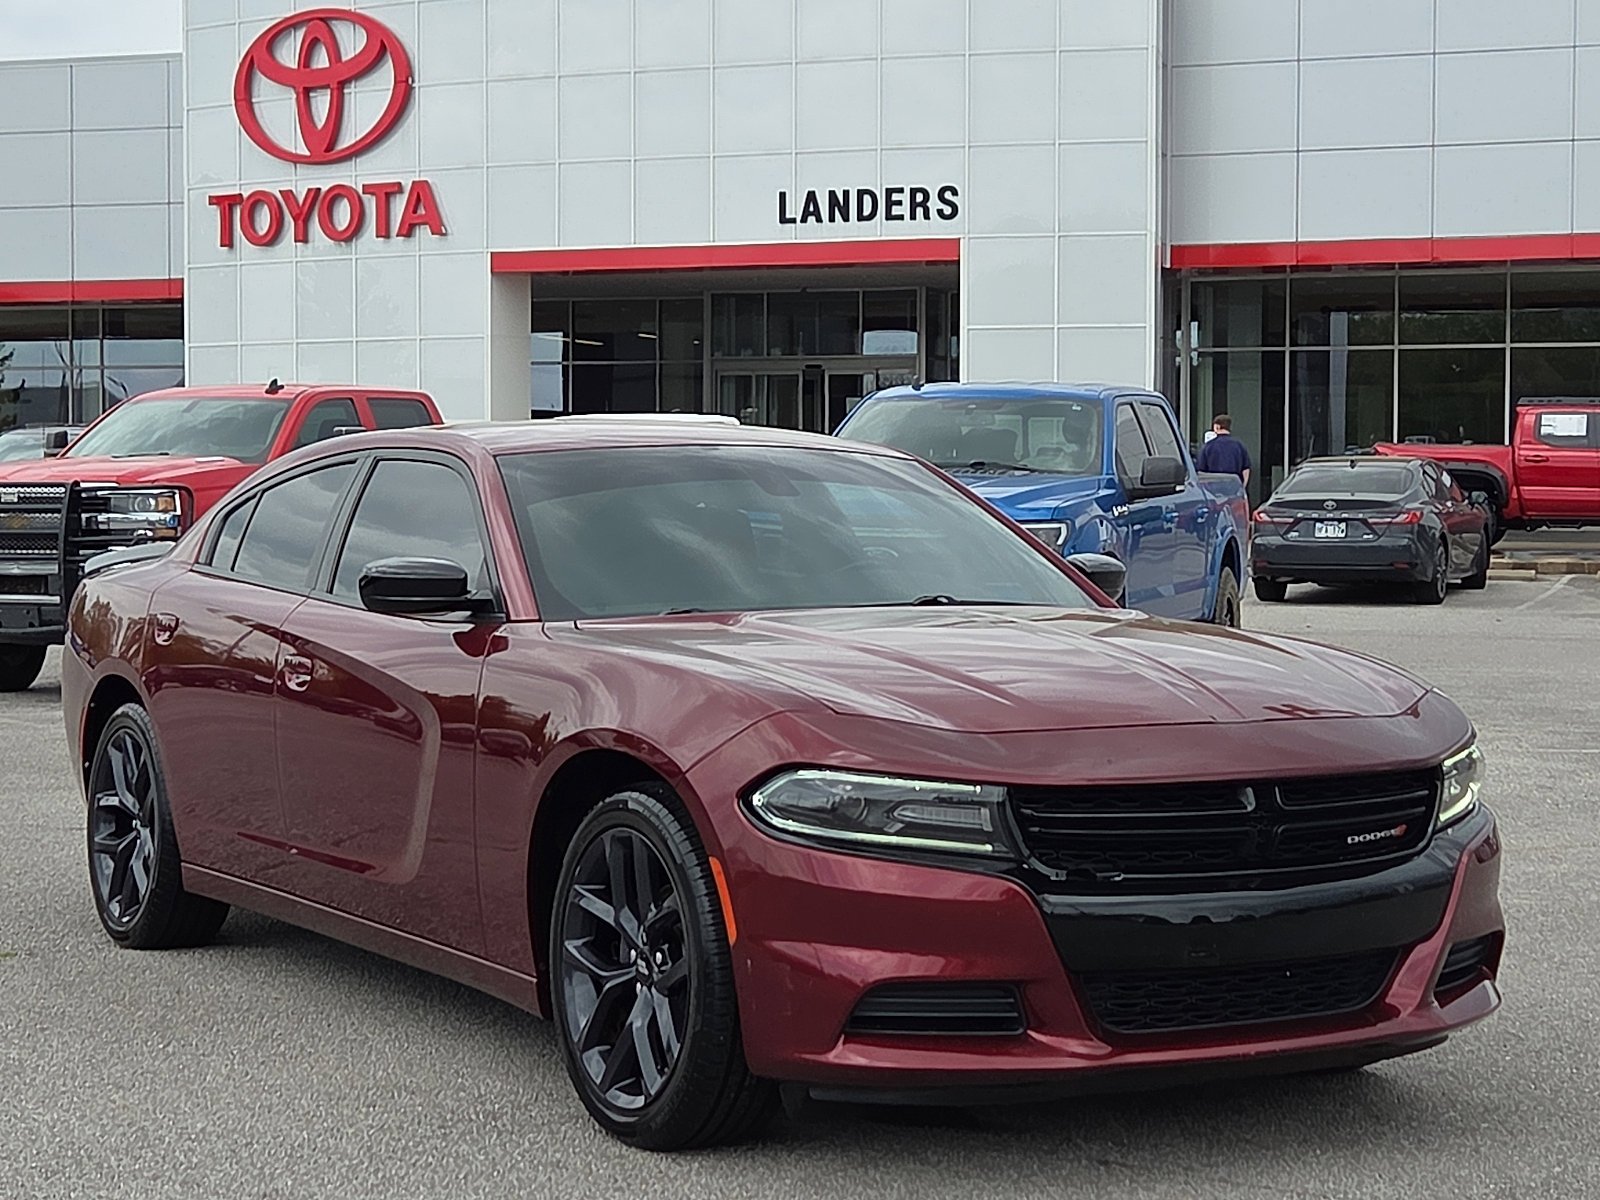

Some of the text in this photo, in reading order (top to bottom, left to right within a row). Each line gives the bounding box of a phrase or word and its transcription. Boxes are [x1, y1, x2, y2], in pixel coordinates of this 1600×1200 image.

[208, 180, 447, 248] TOYOTA
[779, 185, 960, 224] LANDERS
[1347, 828, 1400, 844] DODGE
